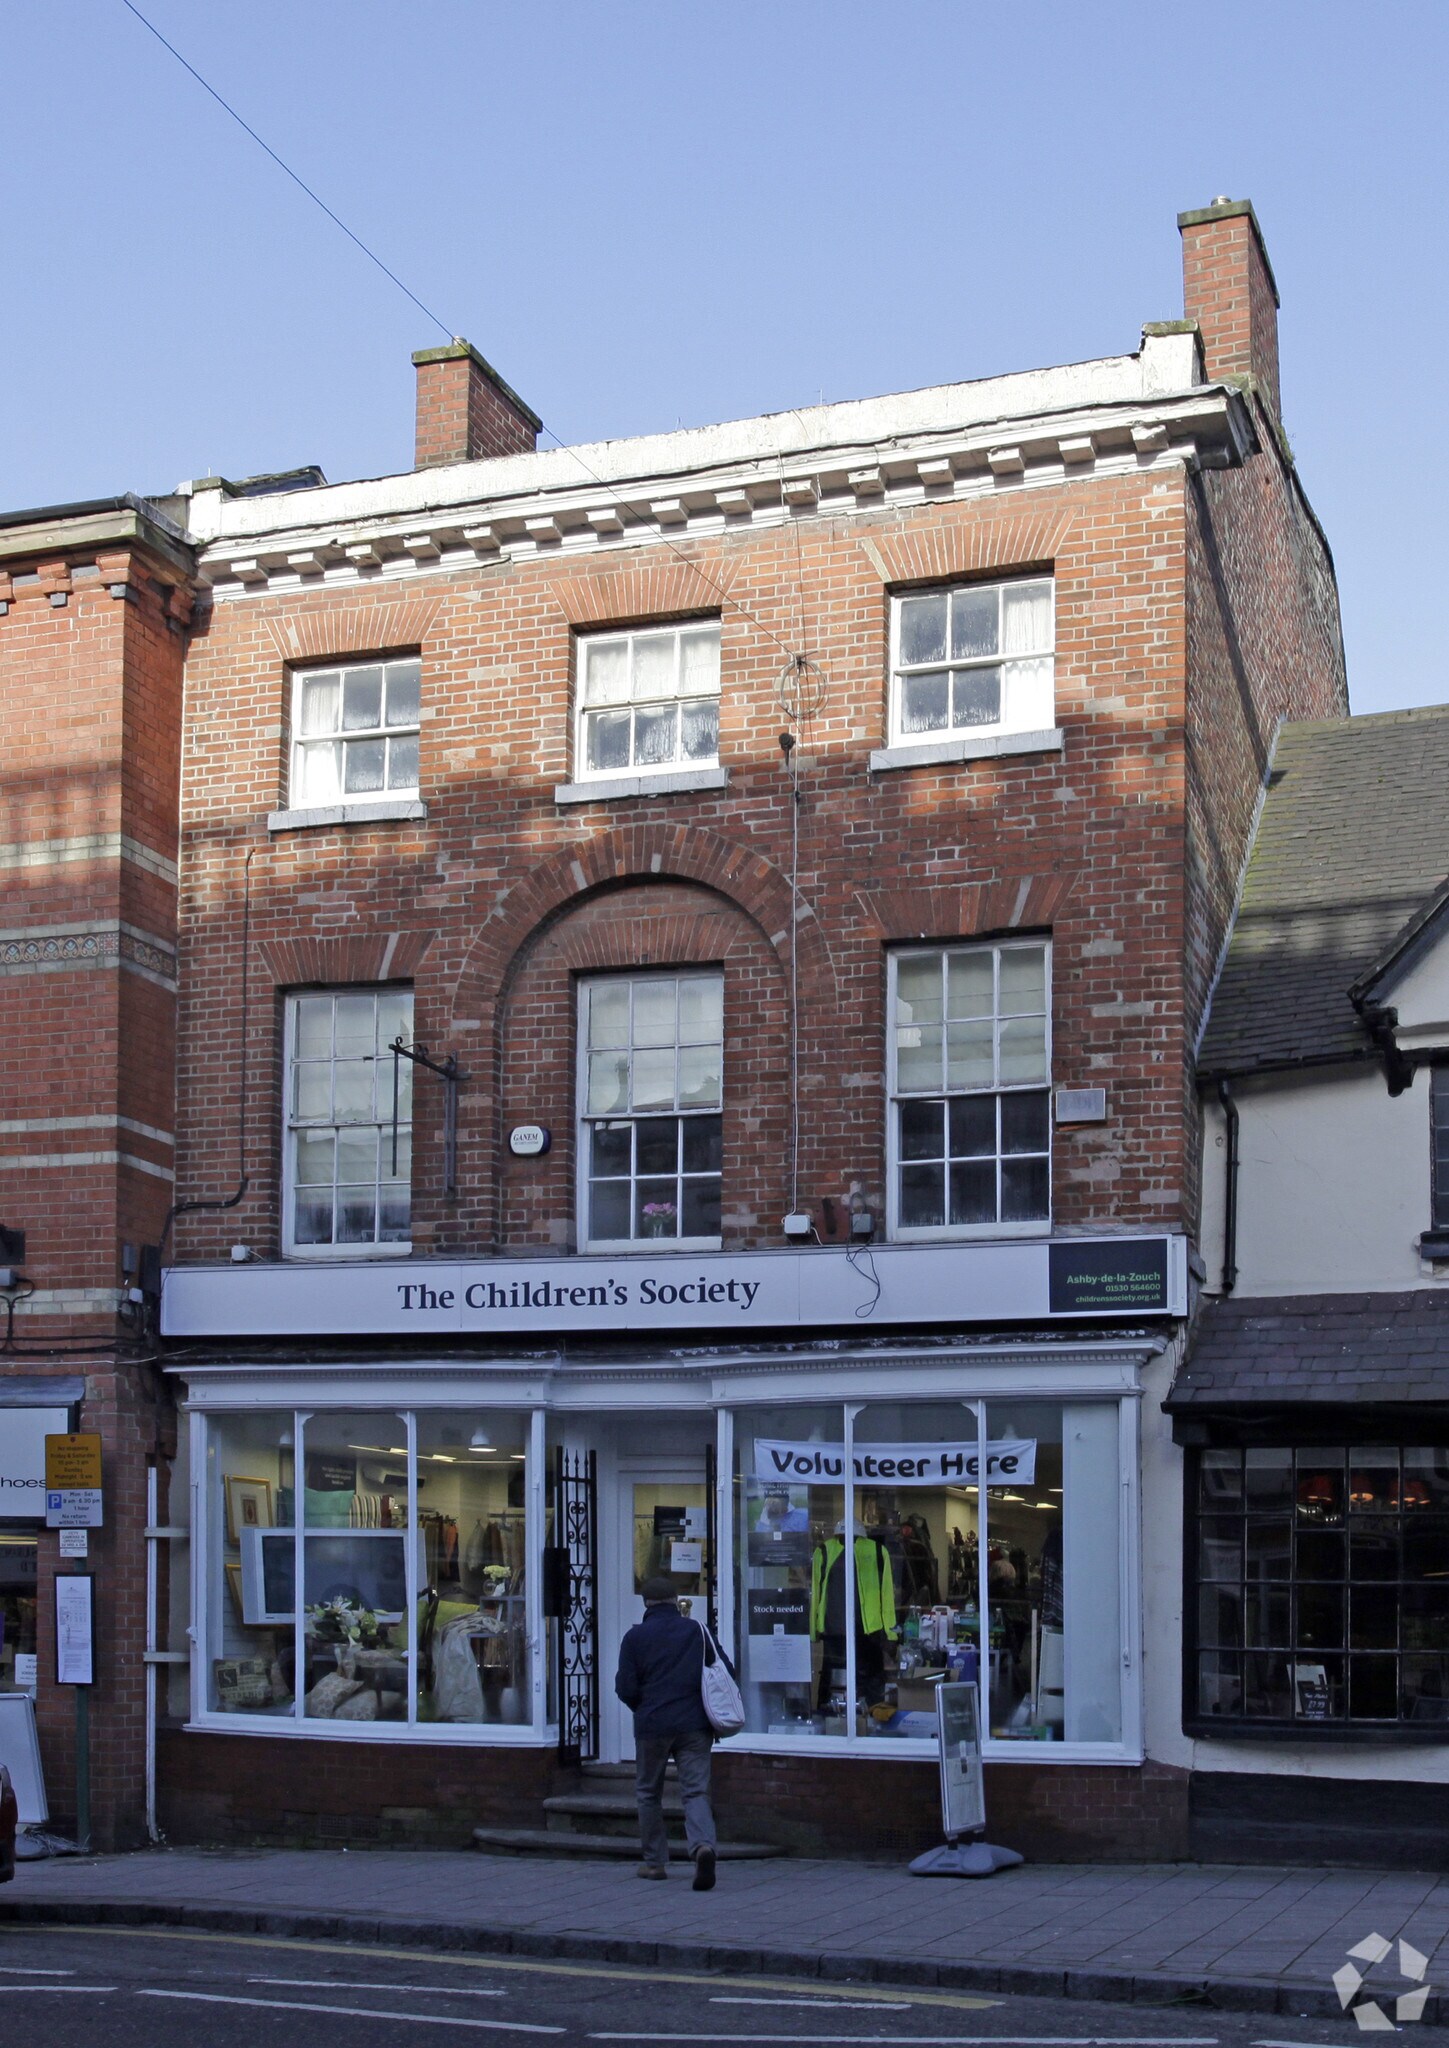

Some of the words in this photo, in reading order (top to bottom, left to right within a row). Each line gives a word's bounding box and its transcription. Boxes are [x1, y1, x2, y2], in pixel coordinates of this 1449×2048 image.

[1066, 1272, 1161, 1285] Ashby-de-la-Zouch
[1130, 1283, 1161, 1291] 564600
[397, 1284, 455, 1310] The
[464, 1278, 628, 1309] Children's
[639, 1276, 761, 1310] Society
[1075, 1293, 1161, 1303] childrenssociety.org.uk
[770, 1450, 931, 1478] Volunteer
[940, 1453, 1019, 1476] Here
[753, 1605, 774, 1613] Stock
[776, 1605, 804, 1613] needed
